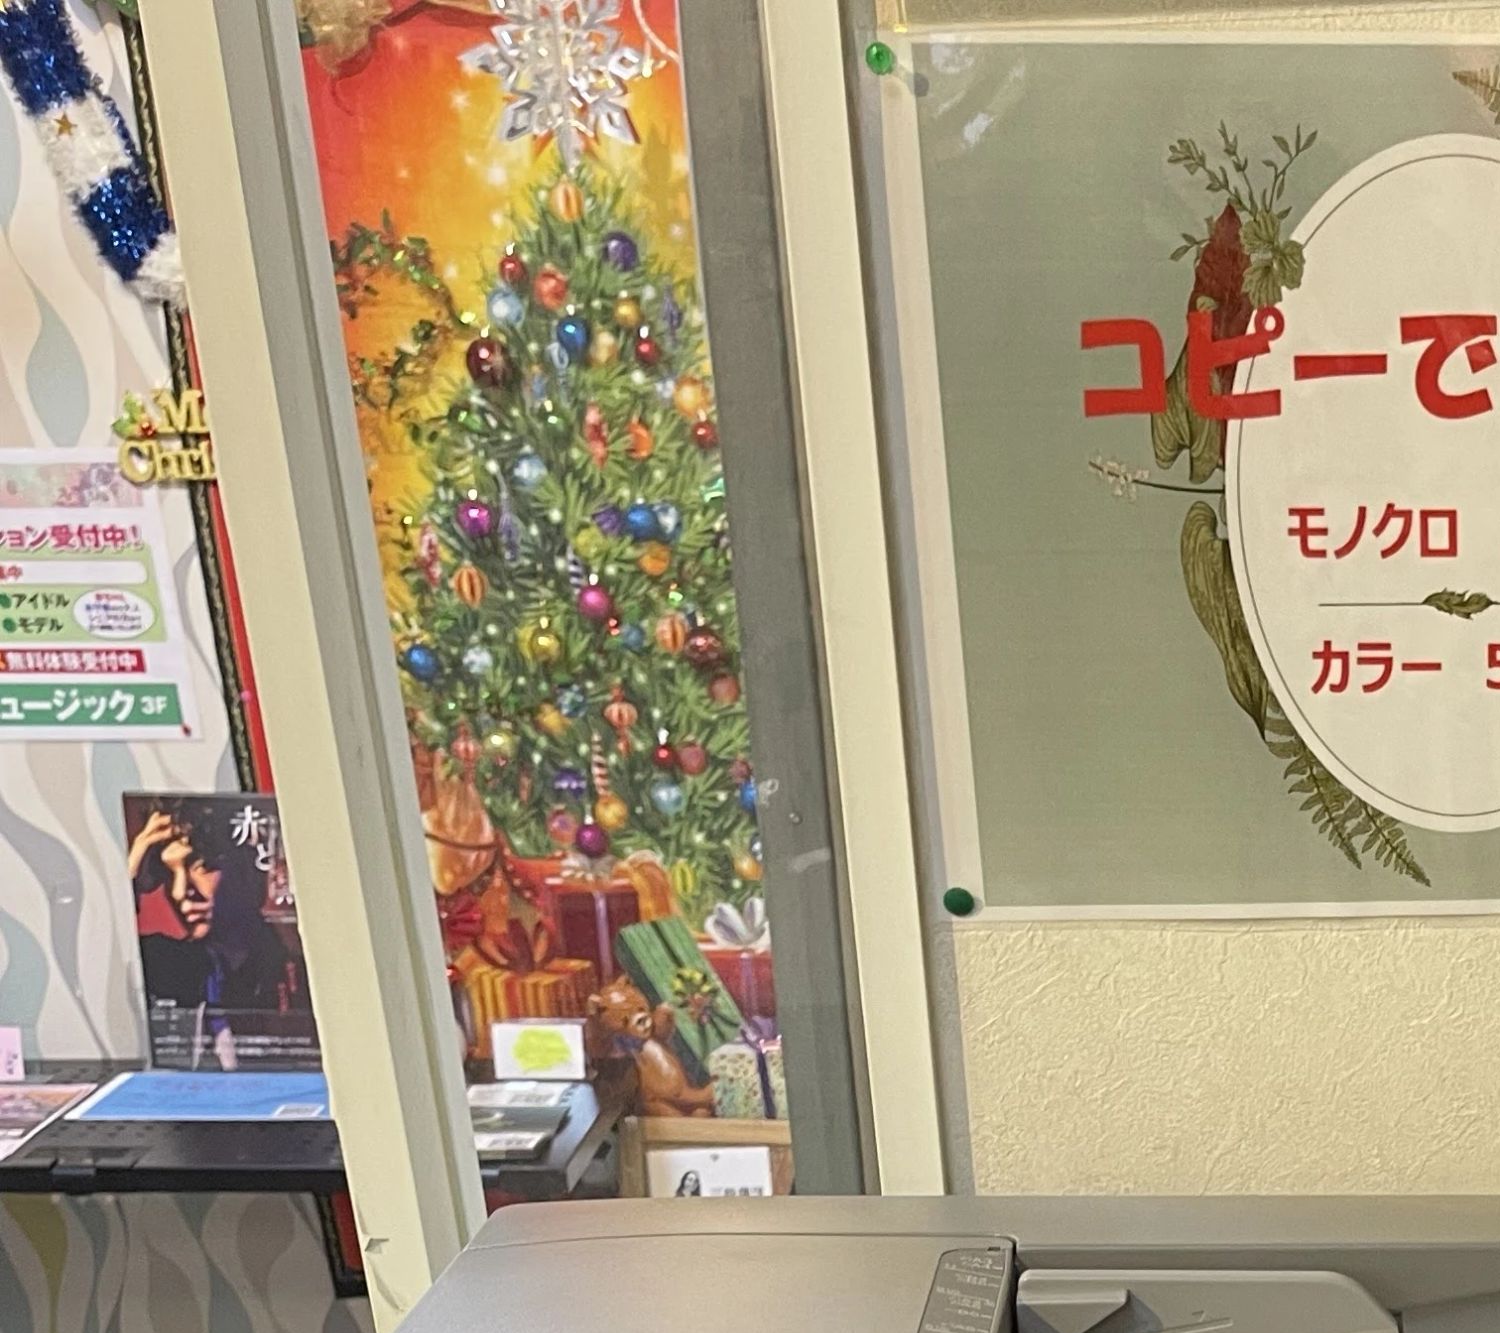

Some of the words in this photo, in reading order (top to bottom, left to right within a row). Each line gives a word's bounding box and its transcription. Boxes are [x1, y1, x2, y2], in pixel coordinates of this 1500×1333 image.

[119, 438, 216, 485] Chri
[0, 524, 141, 549] ョン受付中!
[1288, 502, 1458, 559] モノクロ
[1311, 640, 1442, 694] カラー
[141, 695, 167, 714] 3F
